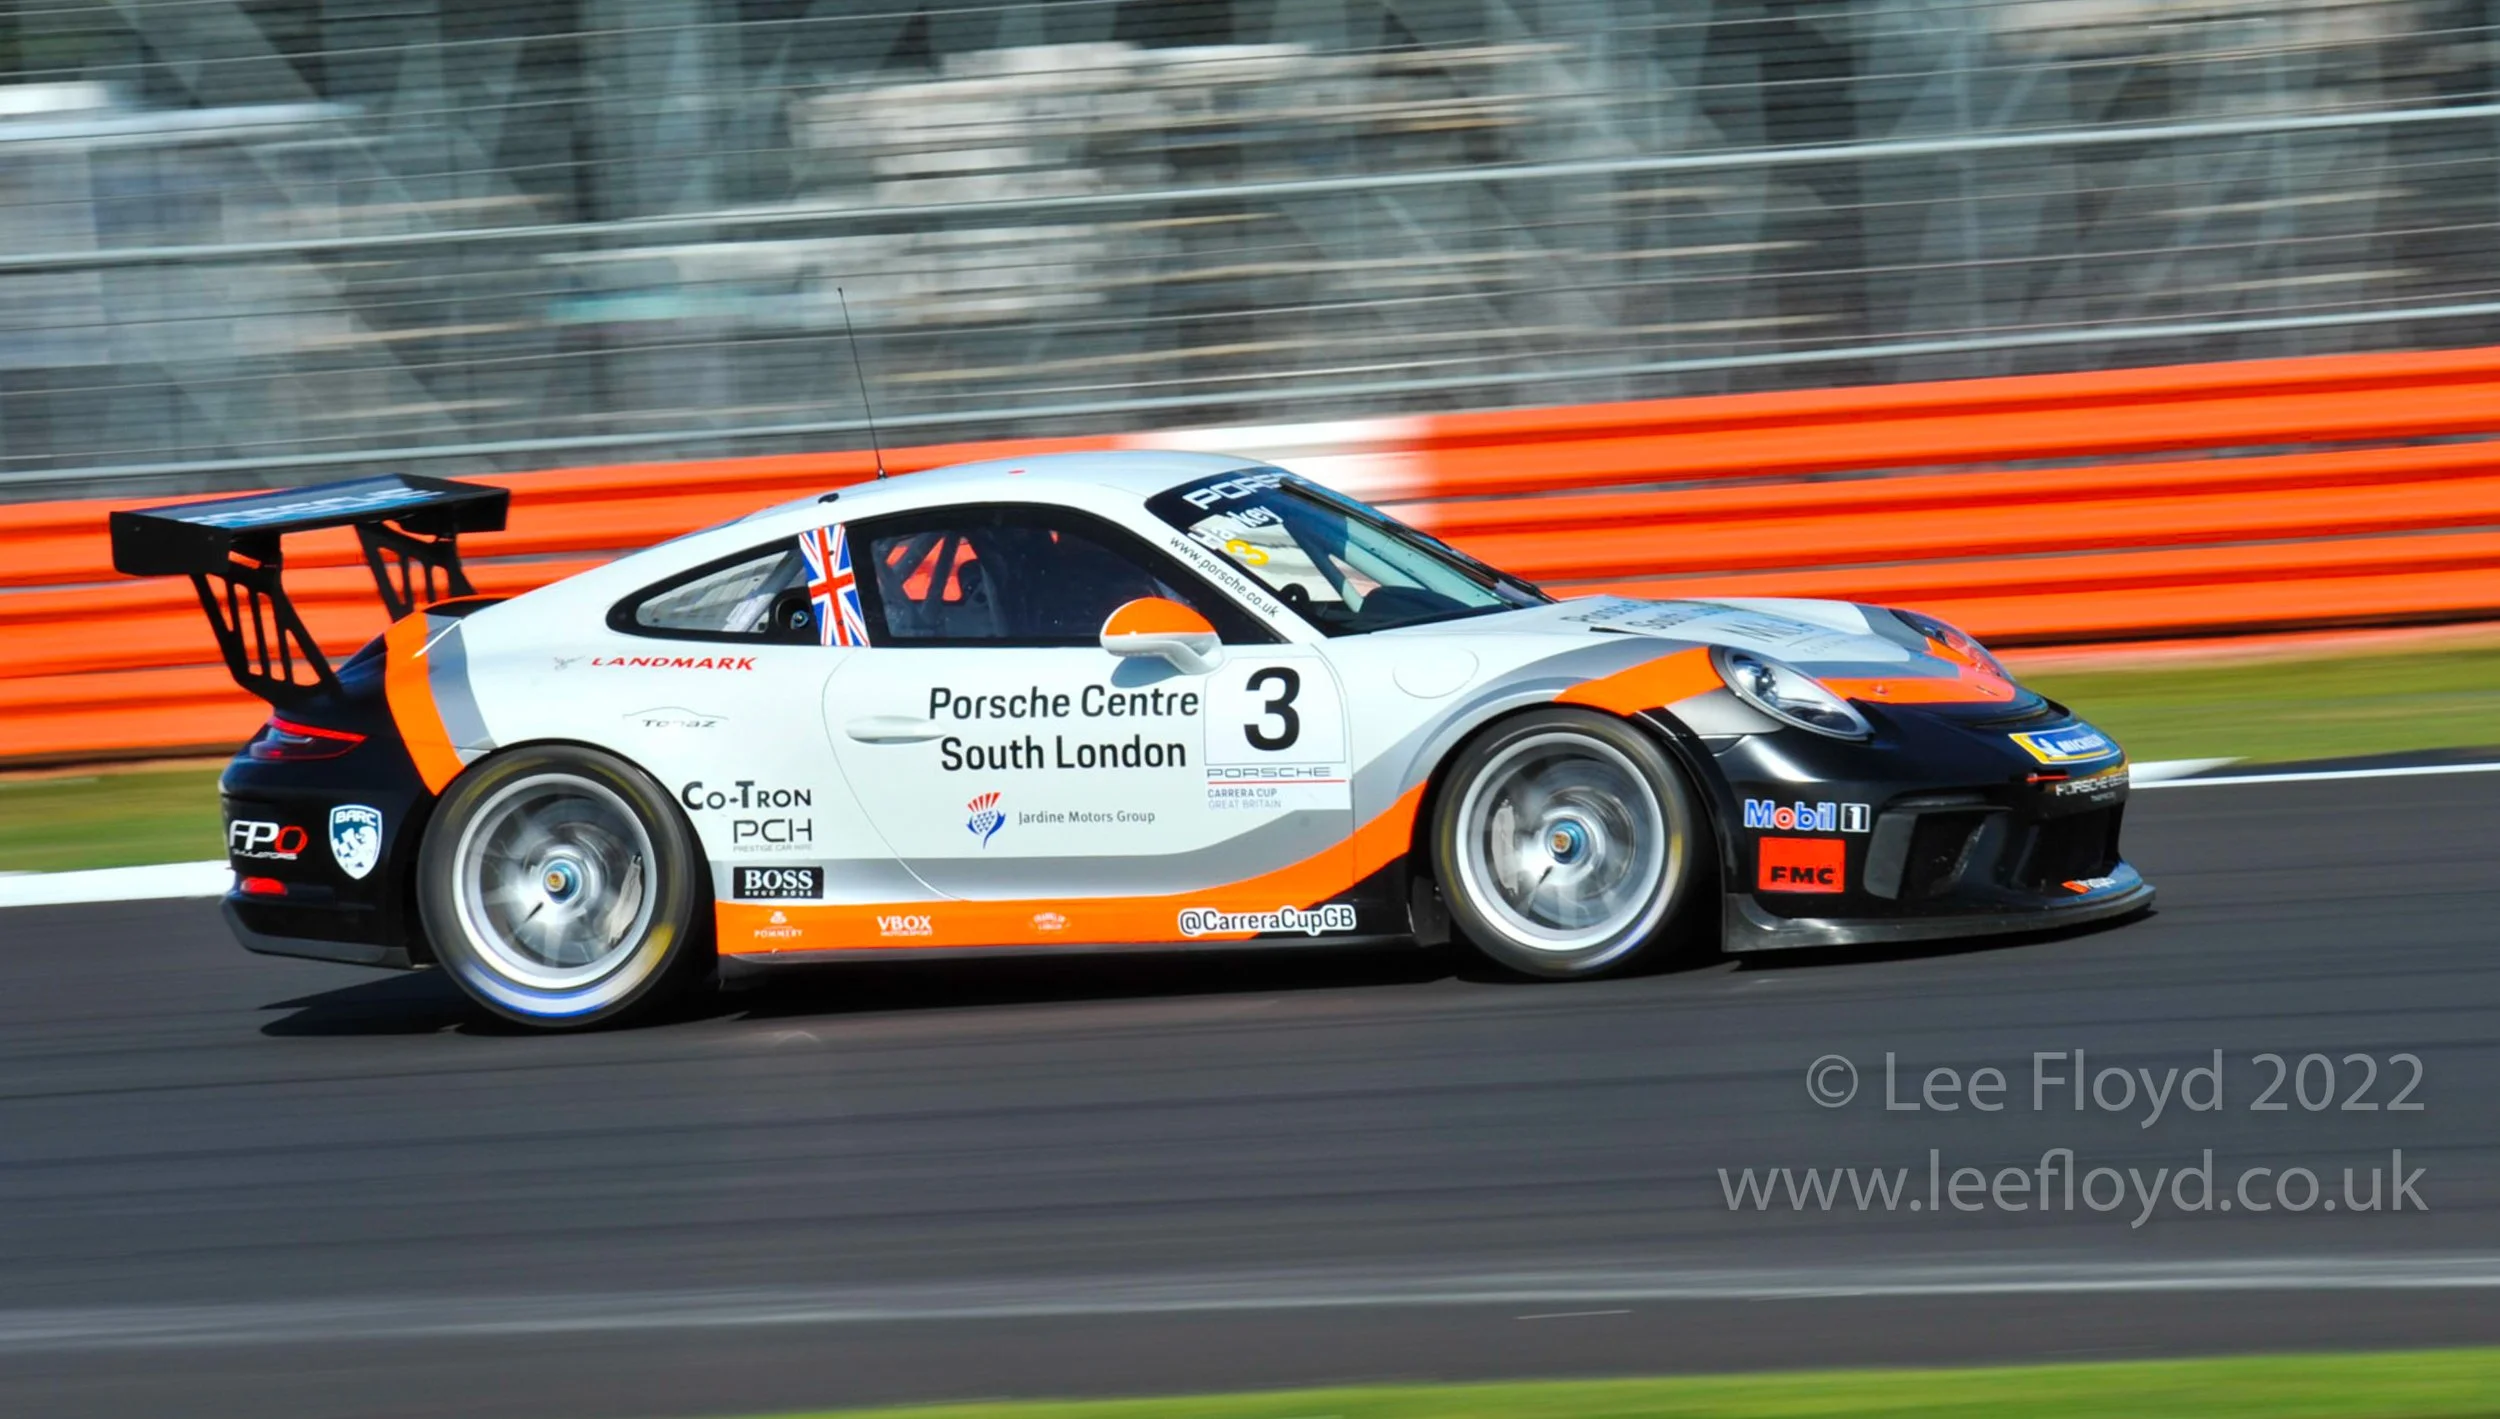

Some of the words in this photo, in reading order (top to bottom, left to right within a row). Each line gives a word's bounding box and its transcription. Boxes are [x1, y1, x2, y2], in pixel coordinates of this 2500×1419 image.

[1182, 472, 1287, 510] PORS
[1225, 538, 1270, 567] 3
[1170, 537, 1279, 618] www.porsche.co.uk
[591, 656, 759, 671] LANDMARK
[929, 685, 1071, 720] Porsche
[1081, 683, 1199, 718] Centre
[1243, 666, 1301, 752] 3
[940, 735, 1045, 771] South
[1055, 733, 1186, 770] London
[1206, 767, 1332, 779] PORSCHE
[1207, 788, 1255, 798] CARRERA
[1256, 787, 1278, 798] CUP
[1208, 800, 1240, 810] GREAT
[1242, 799, 1282, 809] BRITAIN
[335, 810, 377, 826] BARC
[1018, 810, 1065, 825] Jardine
[1068, 810, 1114, 823] Motors
[1116, 809, 1156, 825] Group
[1743, 799, 1837, 831] Mobil
[733, 817, 813, 844] PCH
[744, 869, 814, 890] BOSS
[1771, 865, 1835, 885] FMC
[877, 915, 932, 930] VBOX
[1179, 906, 1355, 935] @CarreraCupGB
